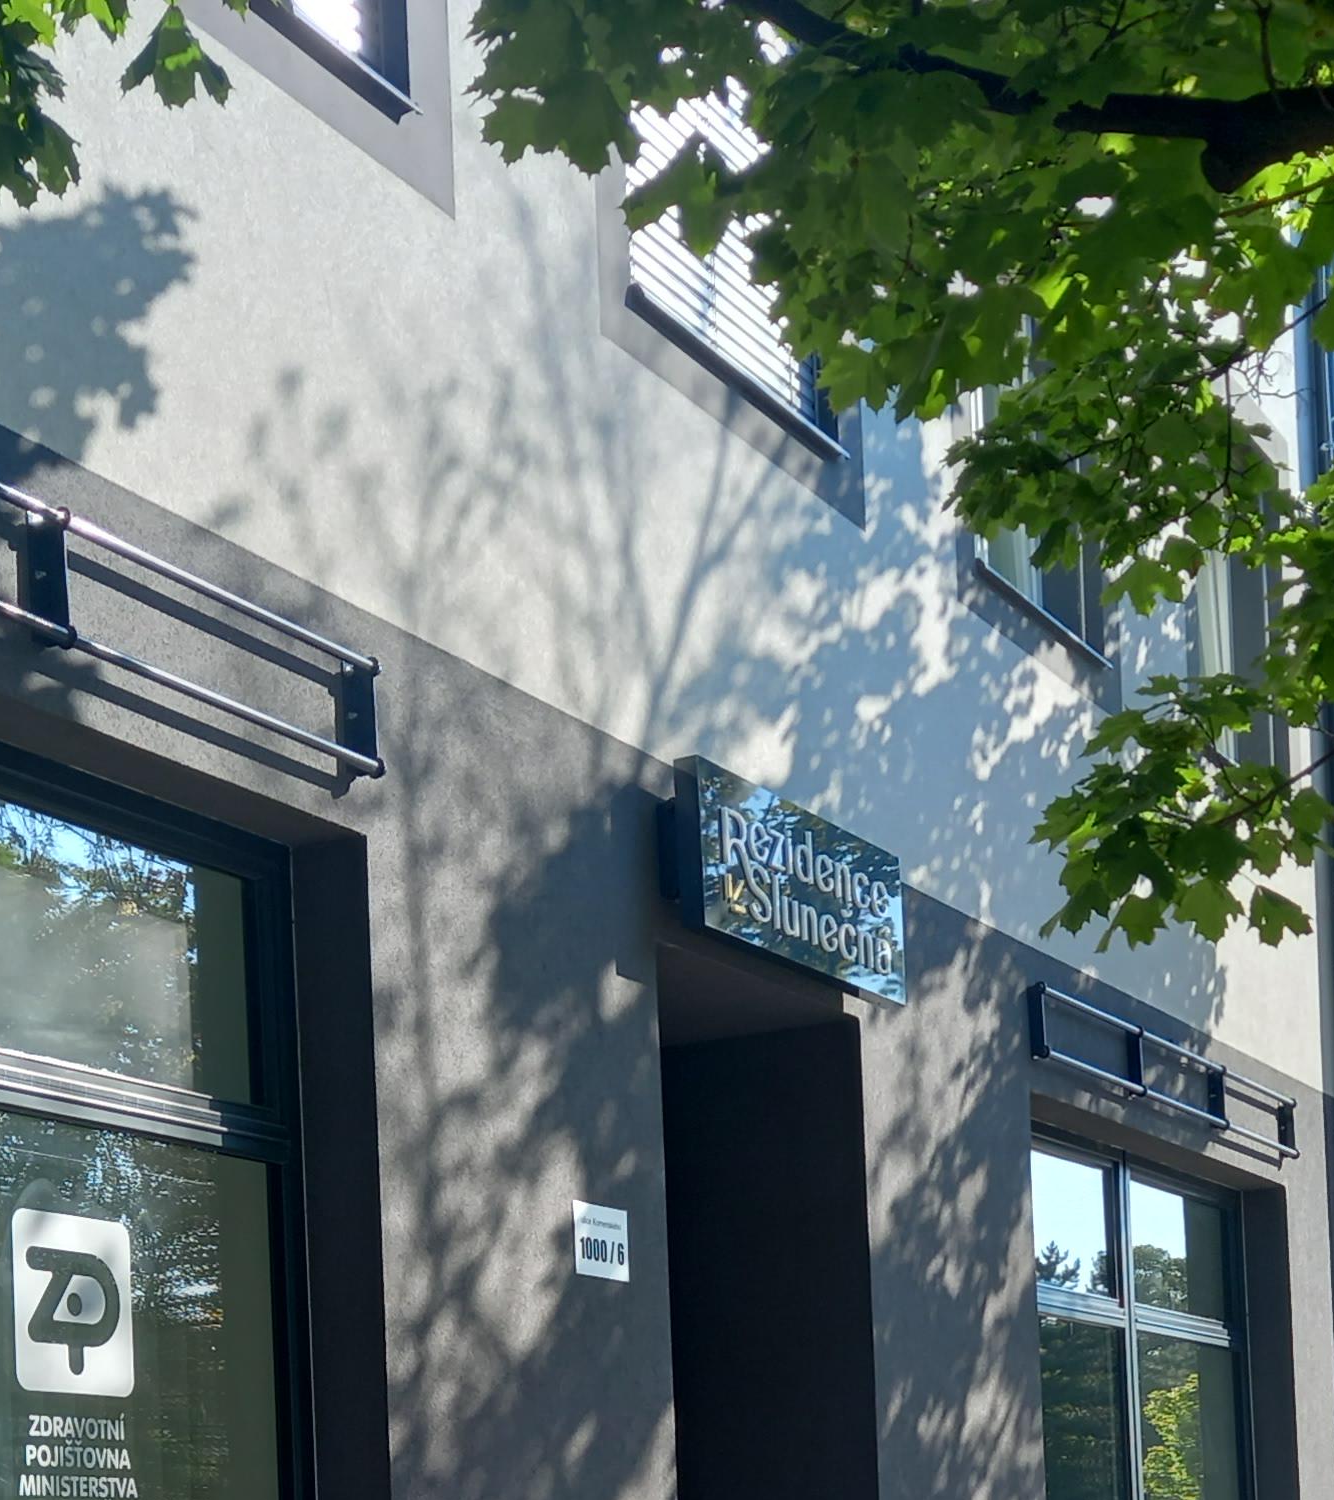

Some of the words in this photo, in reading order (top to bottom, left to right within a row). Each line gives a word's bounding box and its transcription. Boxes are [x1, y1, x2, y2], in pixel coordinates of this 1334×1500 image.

[720, 806, 889, 918] Rezidence
[748, 863, 893, 976] Slunečná
[28, 1412, 125, 1441] ZDRAVOTNÍ
[25, 1439, 132, 1470] POJIŠŤOVNA
[18, 1474, 139, 1499] MINISTERSTVA
